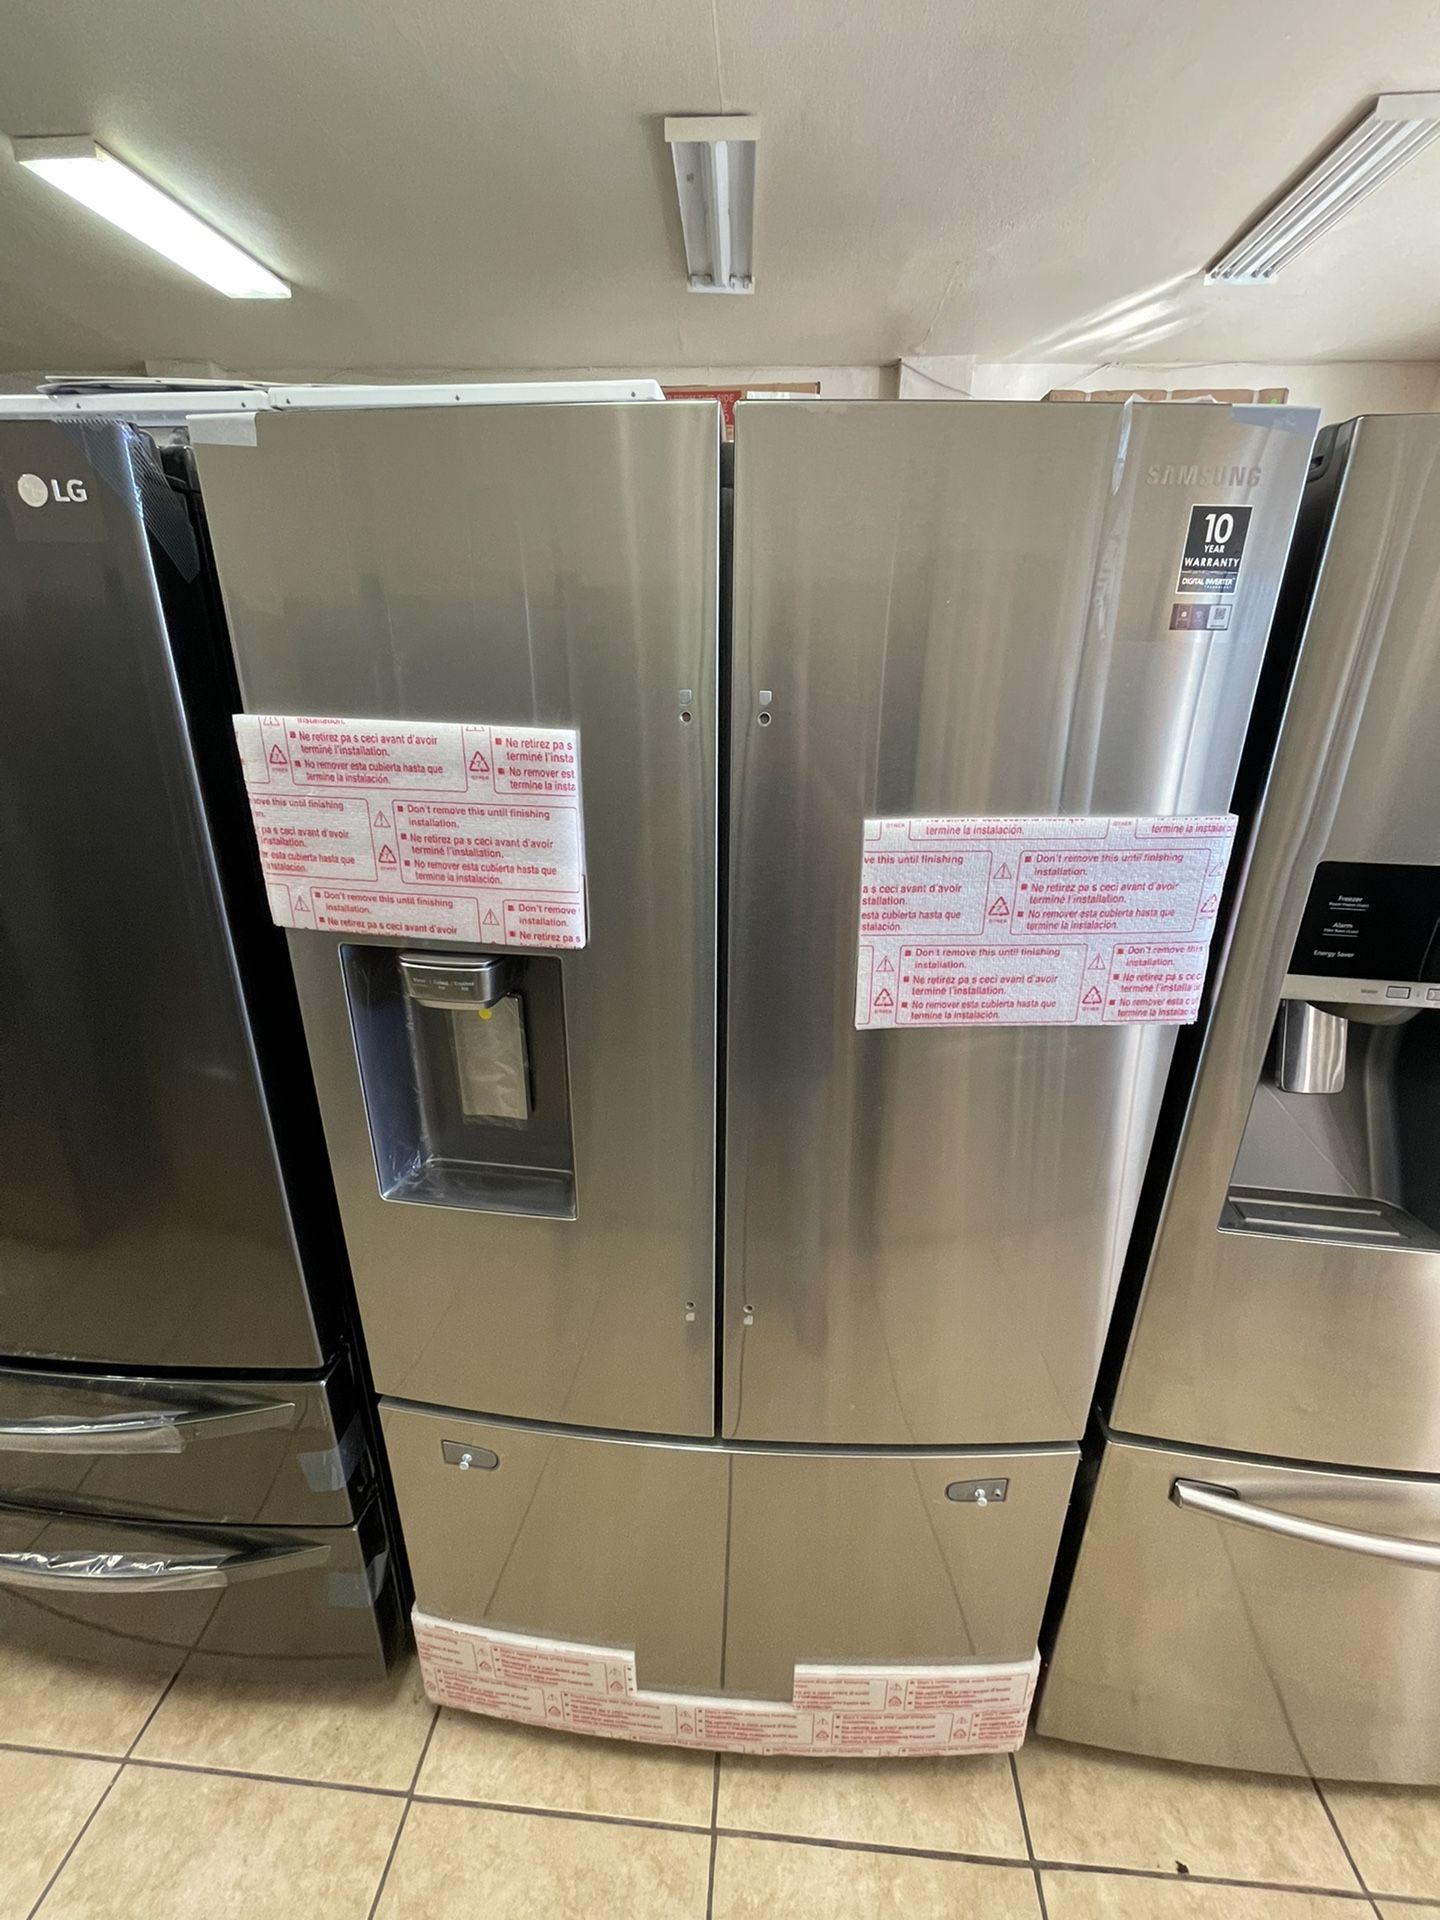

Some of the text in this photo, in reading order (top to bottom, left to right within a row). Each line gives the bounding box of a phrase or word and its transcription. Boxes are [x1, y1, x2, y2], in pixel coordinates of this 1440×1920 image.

[1146, 464, 1262, 488] SAMSUNG
[51, 479, 88, 502] LG
[1205, 513, 1234, 545] 10
[1204, 545, 1225, 553] YEAR
[1184, 557, 1240, 567] WARRANTY
[1181, 577, 1204, 585] DIGITAL
[506, 738, 572, 751] Ne retirez pa s
[433, 807, 466, 816] remove
[468, 807, 485, 816] this
[487, 809, 508, 817] until
[510, 809, 550, 820] finishing
[878, 856, 963, 865] this until finishing
[544, 906, 576, 915] remove
